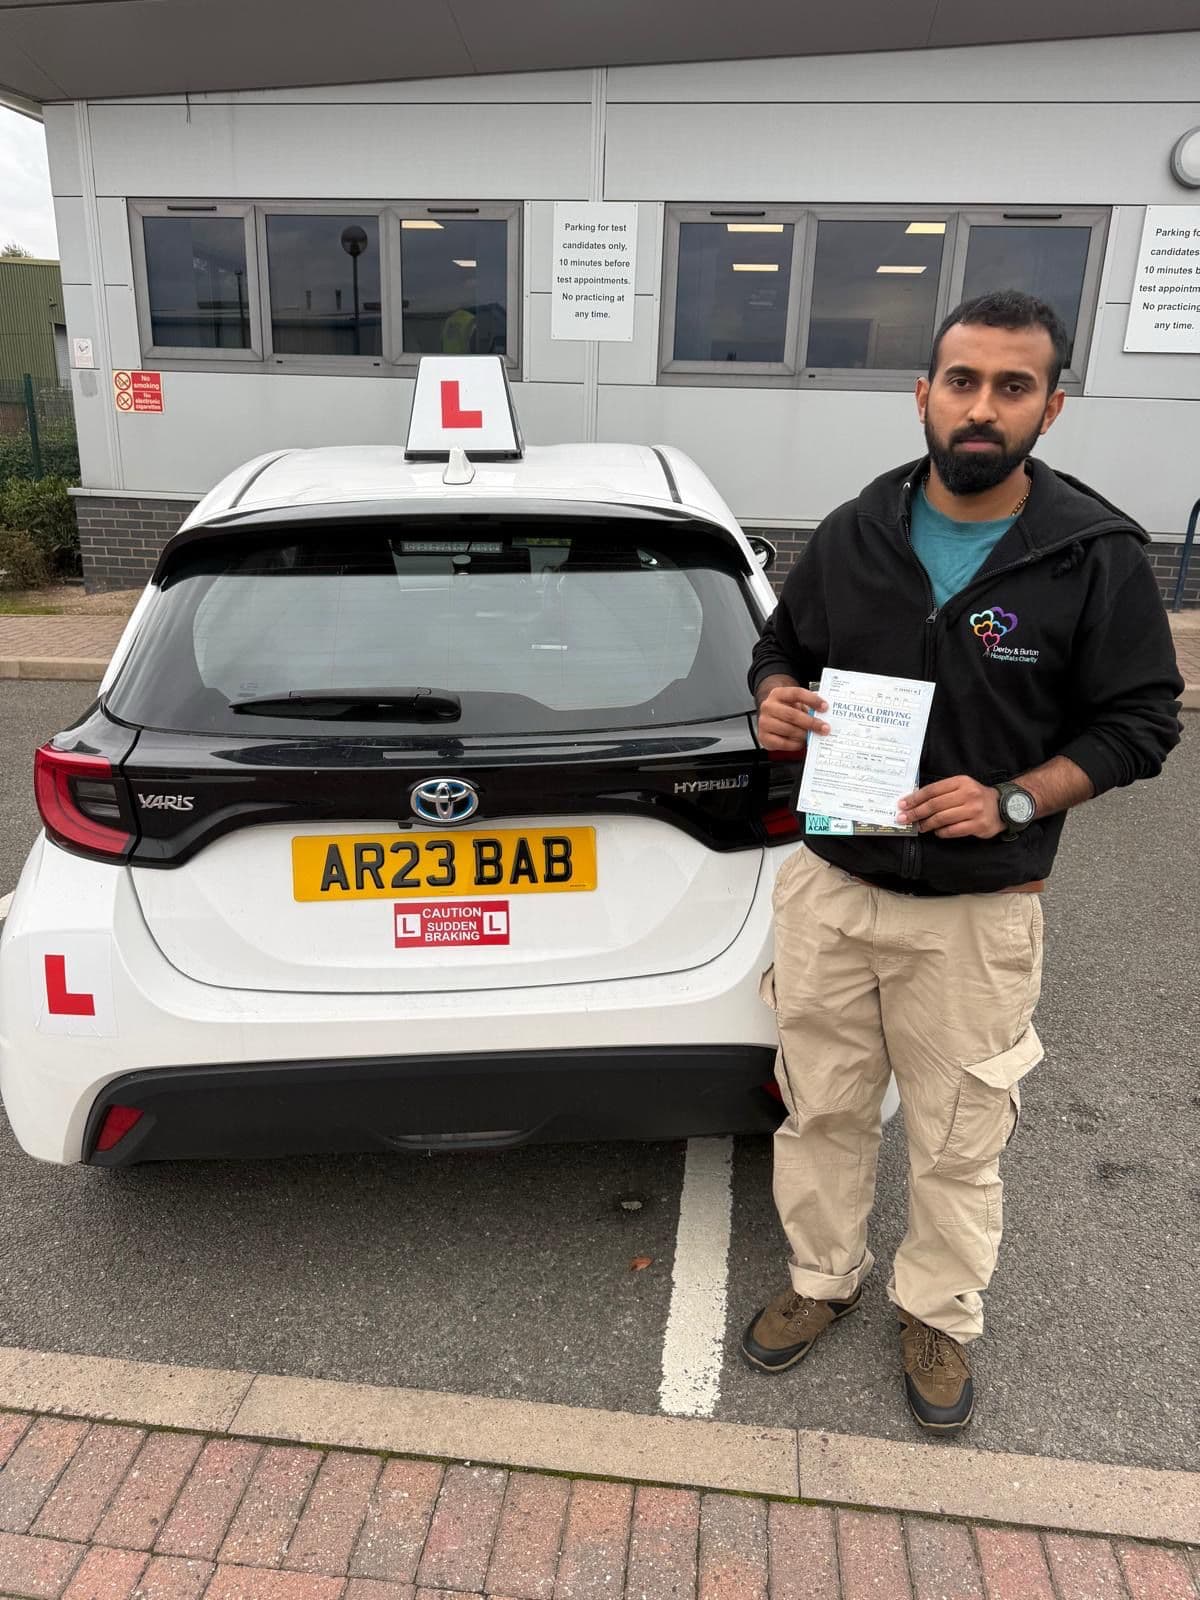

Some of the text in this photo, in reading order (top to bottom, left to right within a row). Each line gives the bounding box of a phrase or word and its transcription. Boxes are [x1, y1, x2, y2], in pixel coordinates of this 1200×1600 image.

[564, 223, 596, 233] Parking
[598, 224, 610, 232] for
[1156, 228, 1190, 239] Parking
[562, 242, 606, 250] candidates
[1150, 248, 1200, 256] candidates
[560, 258, 631, 268] 10 minutes before
[1145, 265, 1155, 274] 10
[1156, 266, 1193, 275] minutes
[557, 276, 632, 286] test appointments.
[1139, 284, 1157, 293] test
[562, 292, 625, 303] No practicing at
[1142, 302, 1155, 311] No
[574, 310, 611, 320] any time.
[1154, 321, 1194, 332] any time.
[141, 374, 151, 382] No
[440, 380, 483, 429] L
[993, 645, 1013, 656] Derby
[990, 652, 1018, 662] Hospitals
[832, 701, 912, 720] PRACTICAL DRIVING
[832, 709, 848, 717] TEST
[848, 712, 866, 720] PASS
[866, 714, 911, 728] CERTIFICATE
[674, 778, 740, 793] HYBRID
[808, 816, 829, 826] WIN
[320, 836, 574, 892] AR23 BAB
[422, 906, 482, 919] CAUTION
[402, 917, 416, 934] L
[427, 921, 477, 932] SUDDEN
[488, 914, 502, 931] L
[424, 931, 480, 942] BRAKING
[44, 954, 96, 1017] L
